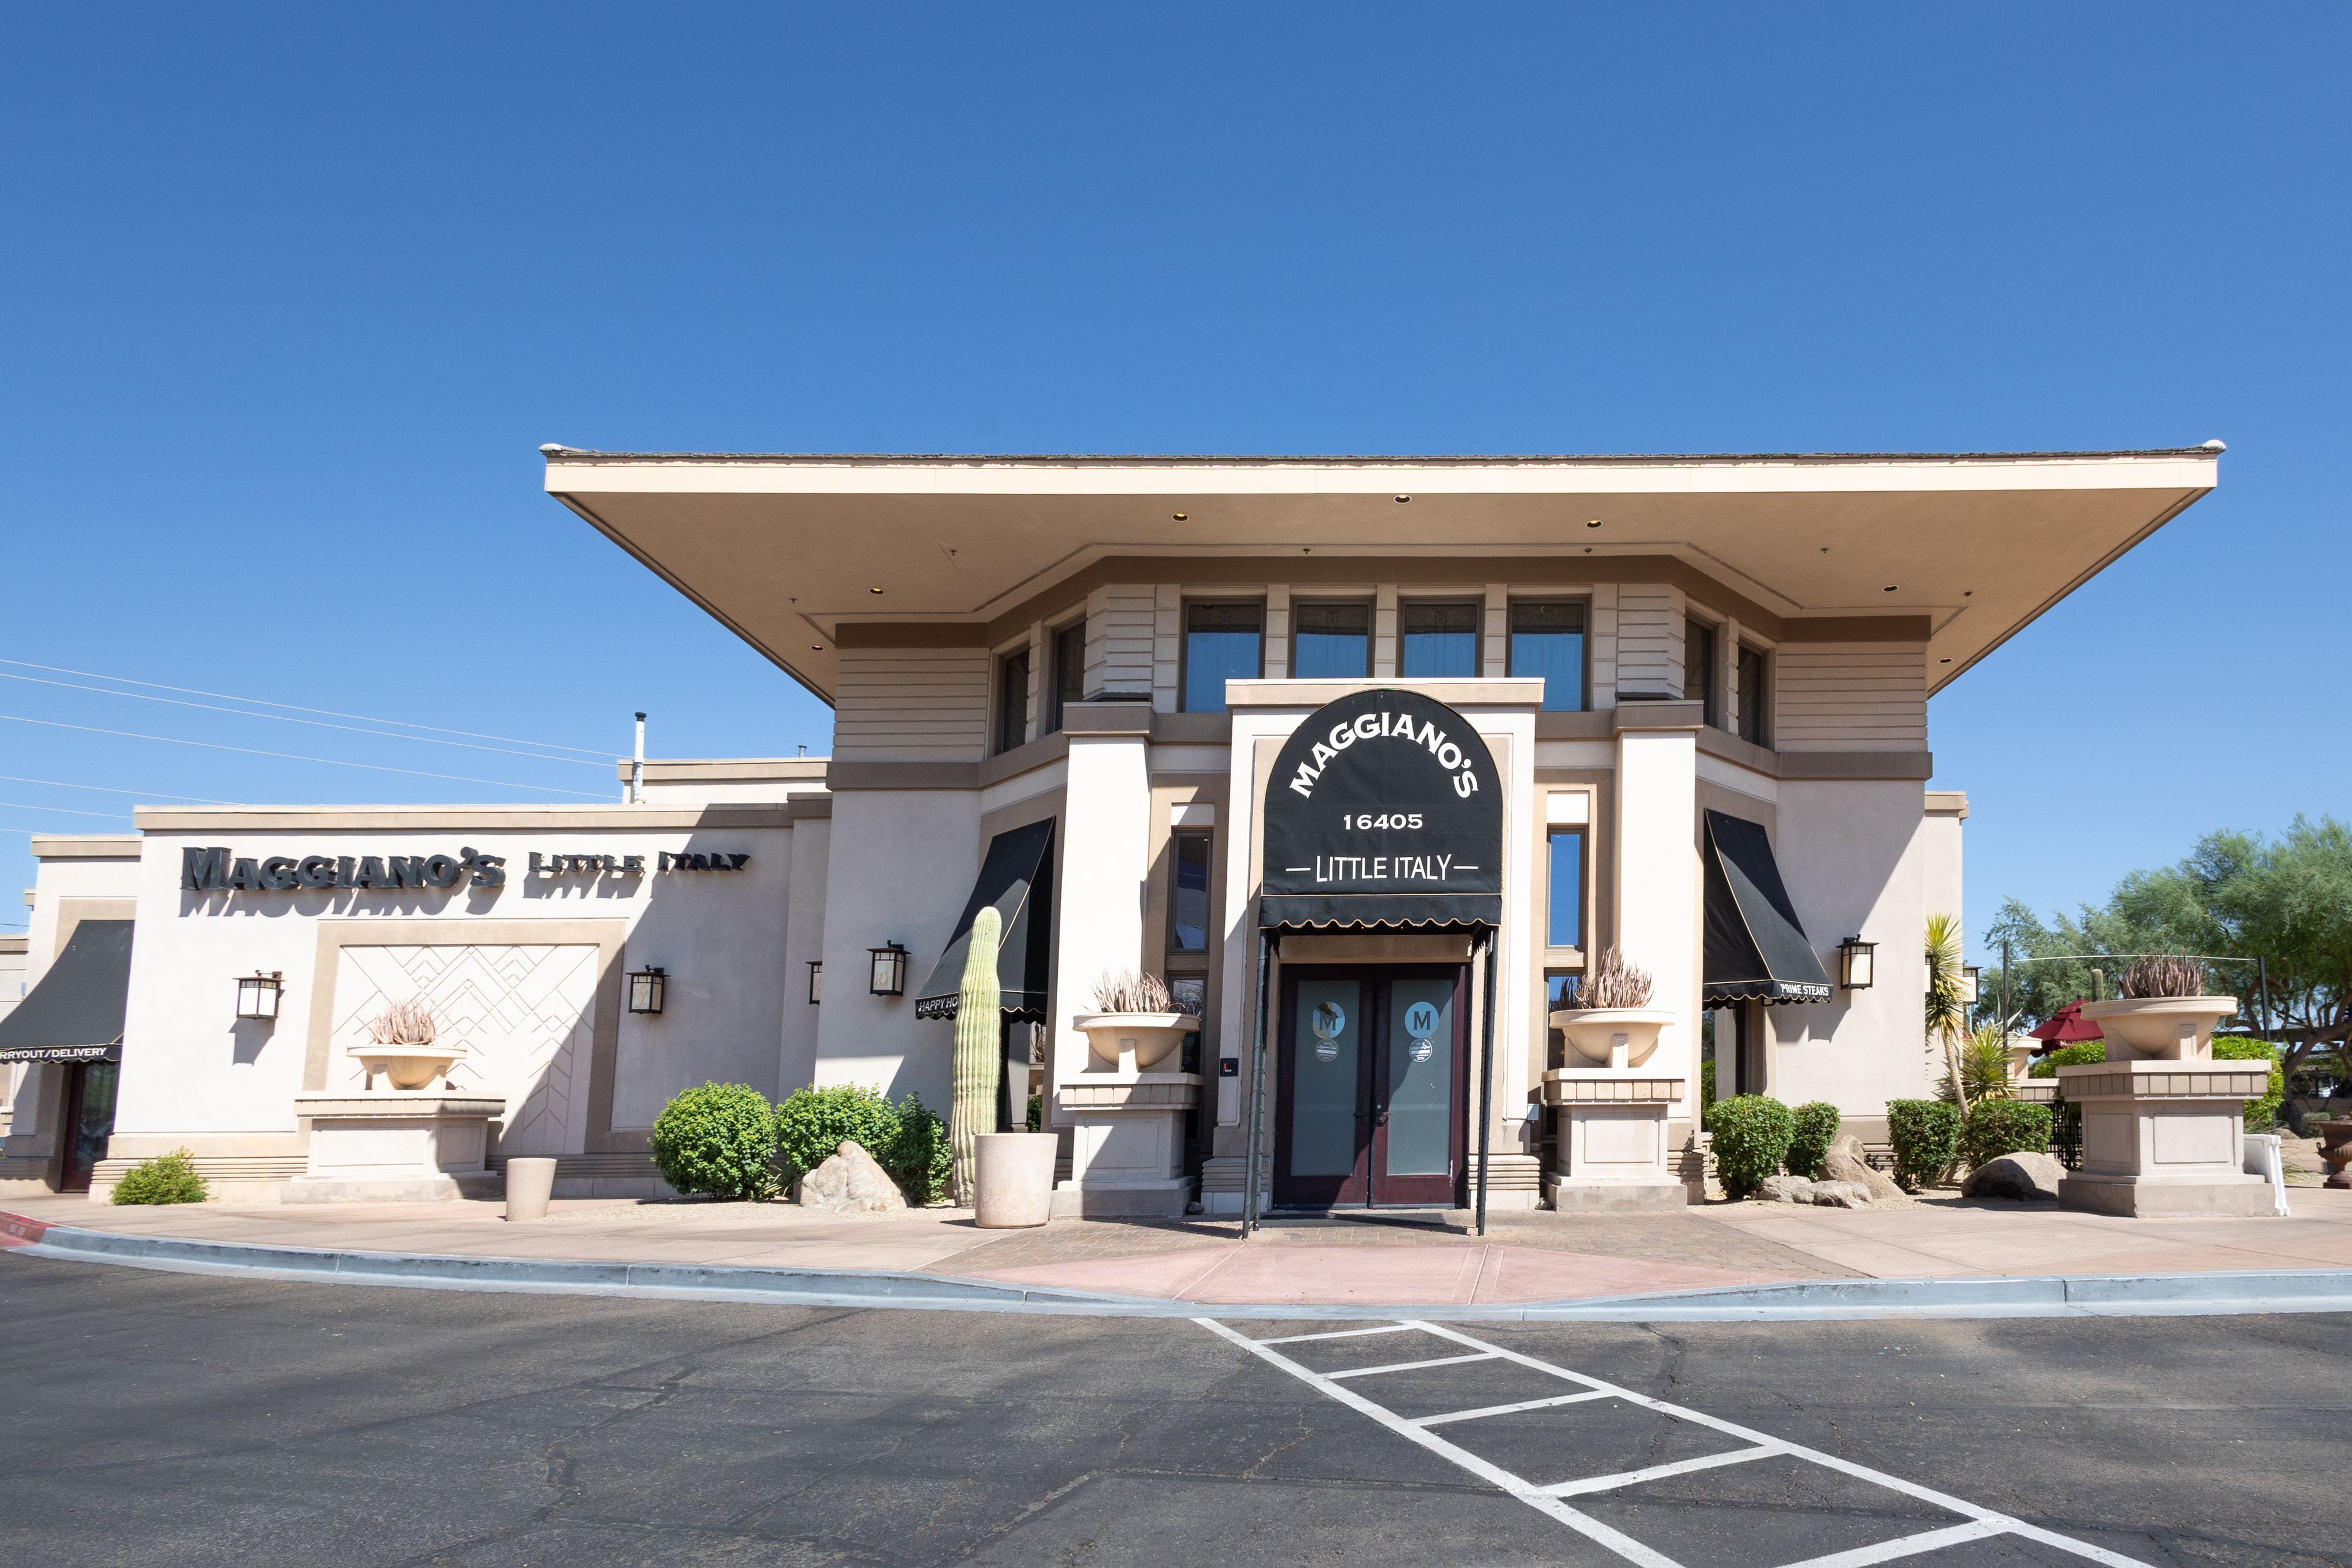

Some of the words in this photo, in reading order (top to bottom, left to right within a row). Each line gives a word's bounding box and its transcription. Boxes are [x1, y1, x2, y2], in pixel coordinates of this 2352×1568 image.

[1289, 712, 1479, 799] MAGGIANO'S
[1343, 813, 1423, 830] 16405
[180, 846, 507, 891] MAGGIANO'S
[528, 851, 646, 872] LITTLE
[657, 851, 751, 871] ITALY
[1316, 855, 1387, 883] LITTLE
[1394, 854, 1452, 881] ITALY
[1780, 983, 1803, 994] PRIME
[1803, 985, 1829, 996] STEAKS
[918, 998, 946, 1012] HAPPY
[946, 997, 959, 1008] HO
[1319, 1011, 1337, 1031] M
[1413, 1011, 1431, 1030] M
